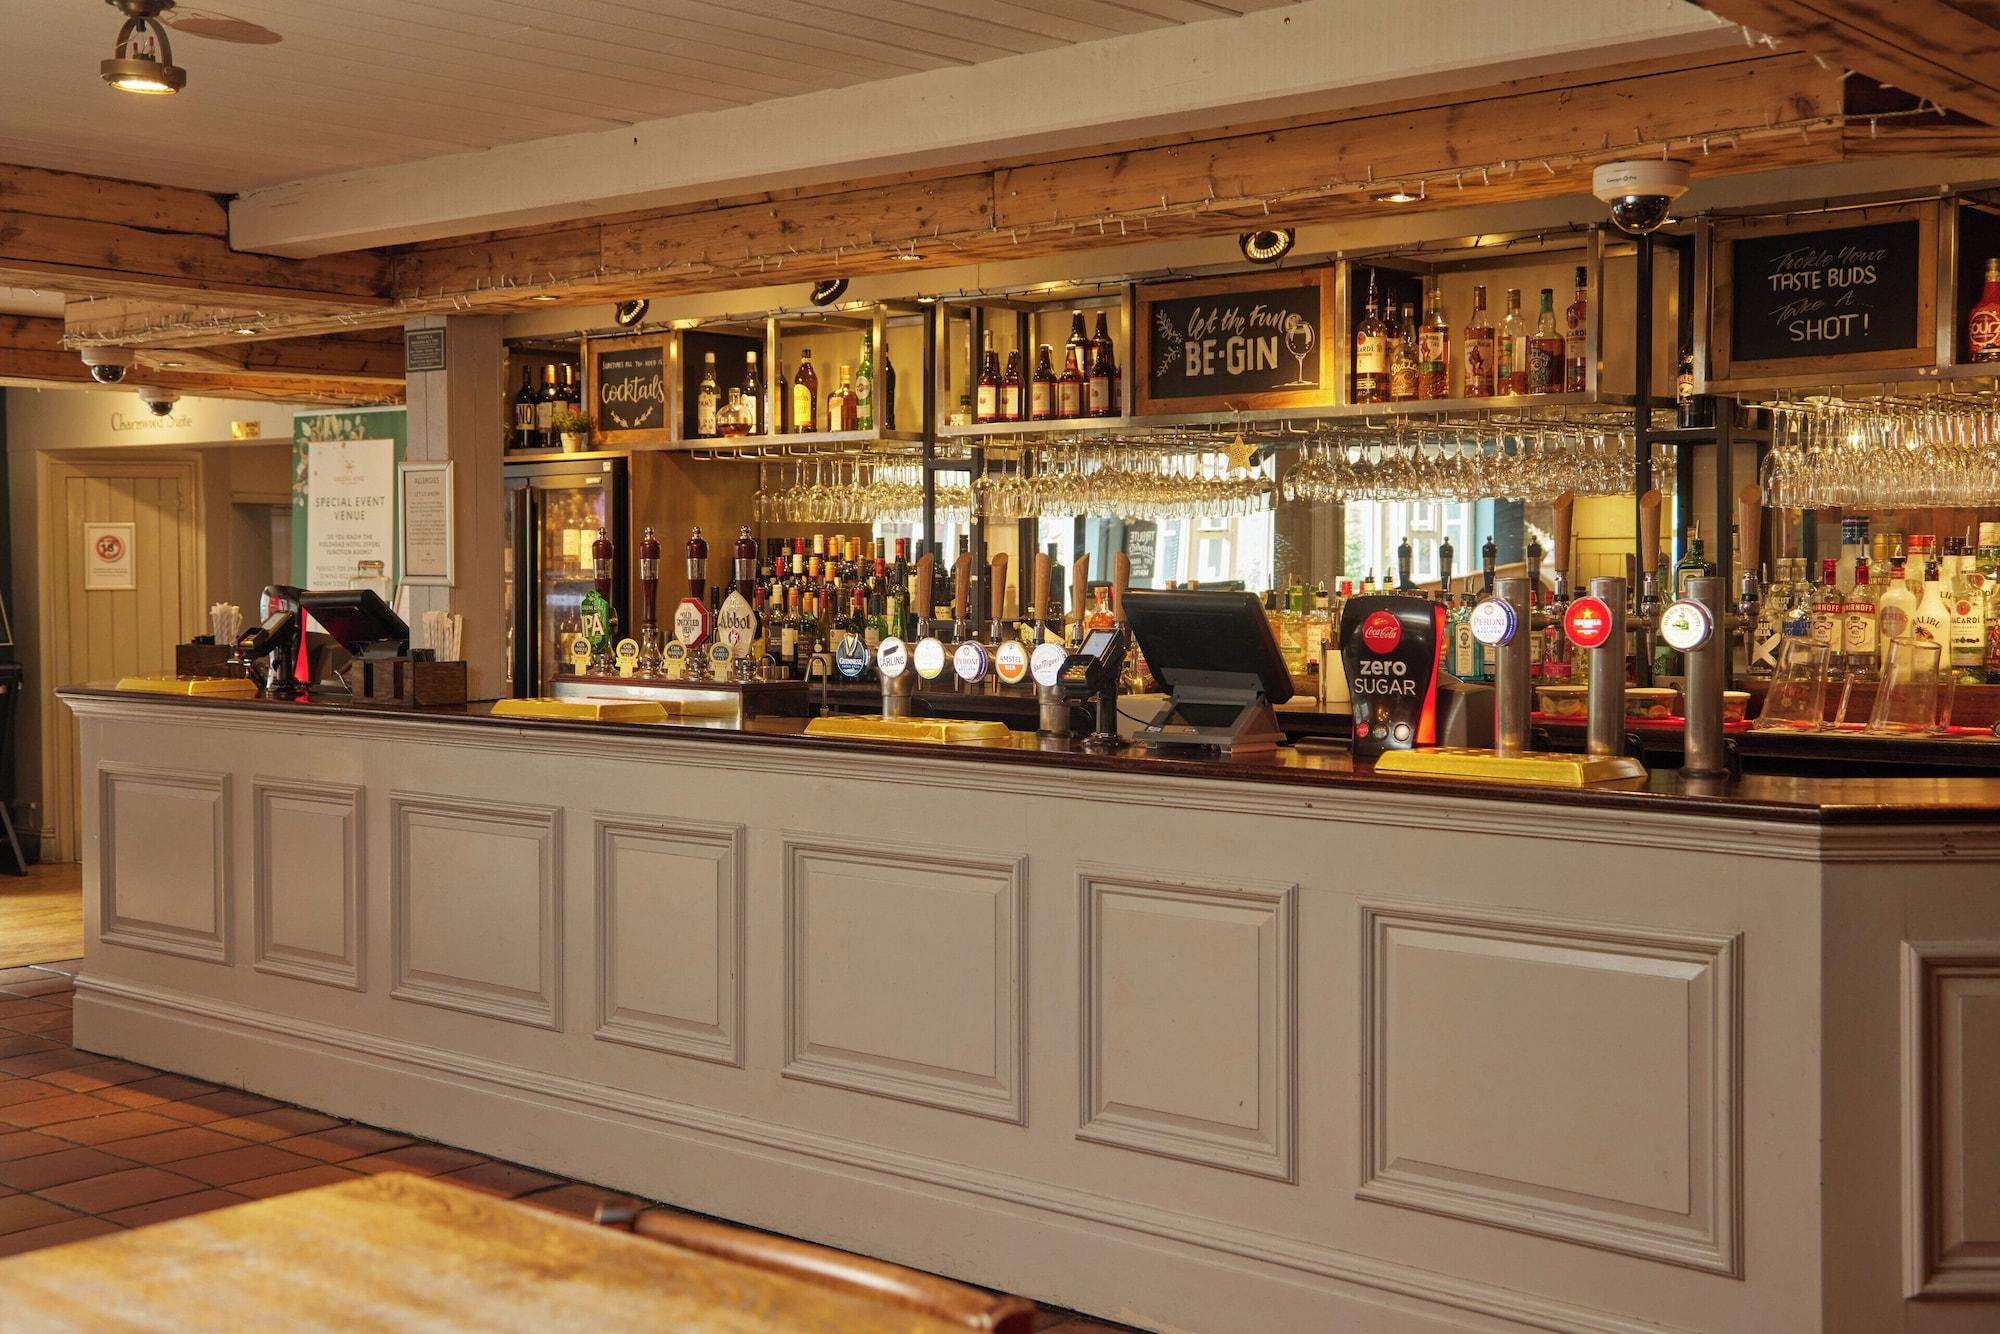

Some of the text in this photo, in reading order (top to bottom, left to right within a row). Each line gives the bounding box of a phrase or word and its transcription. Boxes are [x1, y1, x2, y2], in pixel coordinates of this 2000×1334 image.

[1837, 246, 1888, 263] Your
[1768, 265, 1877, 292] TASTE BUDS
[1768, 299, 1825, 325] Take
[1221, 306, 1246, 336] the
[315, 496, 385, 507] SPECIAL EVENT
[334, 510, 365, 520] VENUE
[581, 613, 605, 637] IPA
[718, 611, 751, 630] Abbot
[1473, 617, 1505, 626] PERONI
[879, 655, 905, 668] CARLING
[999, 655, 1022, 663] AMSTEL
[1359, 660, 1407, 676] zero
[1354, 678, 1416, 696] SUGAR
